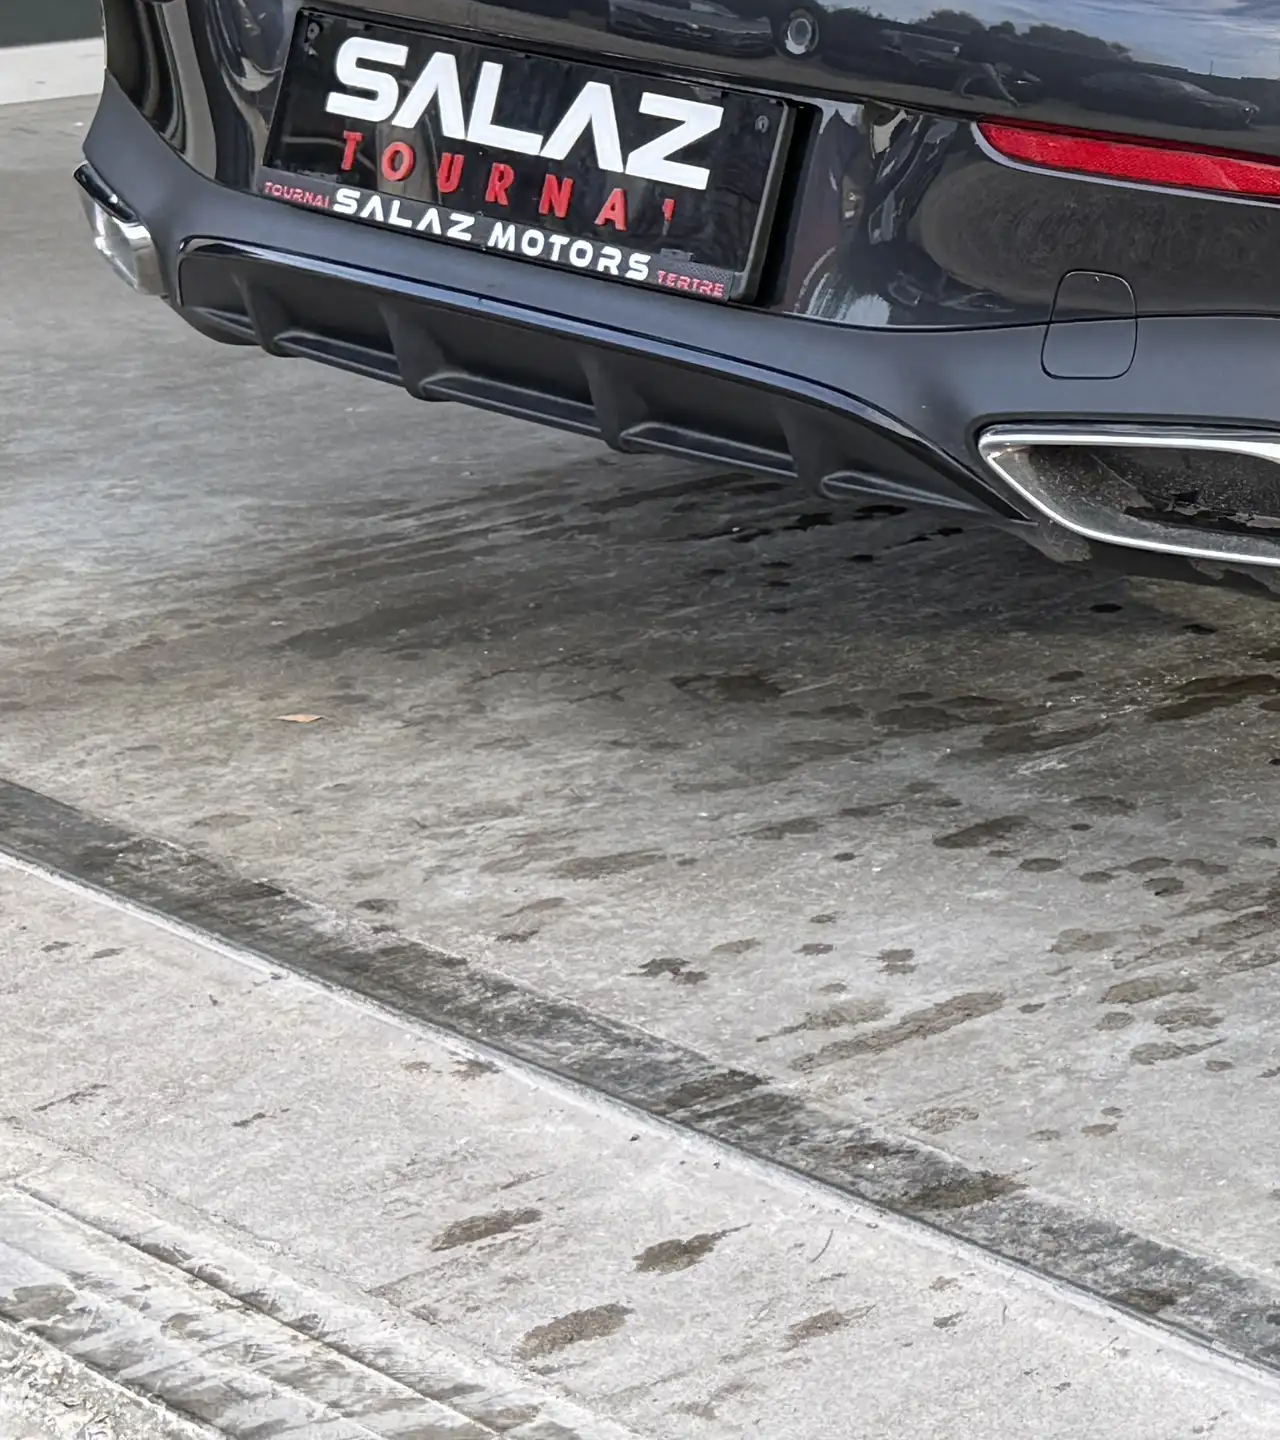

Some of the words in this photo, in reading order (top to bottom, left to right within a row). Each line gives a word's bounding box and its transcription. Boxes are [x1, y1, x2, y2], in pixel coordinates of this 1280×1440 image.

[325, 36, 725, 191] SALAZ
[264, 181, 331, 209] TOURNAI
[333, 187, 476, 242] SALAZ
[487, 221, 652, 282] MOTORS
[656, 270, 725, 298] TERTRE
